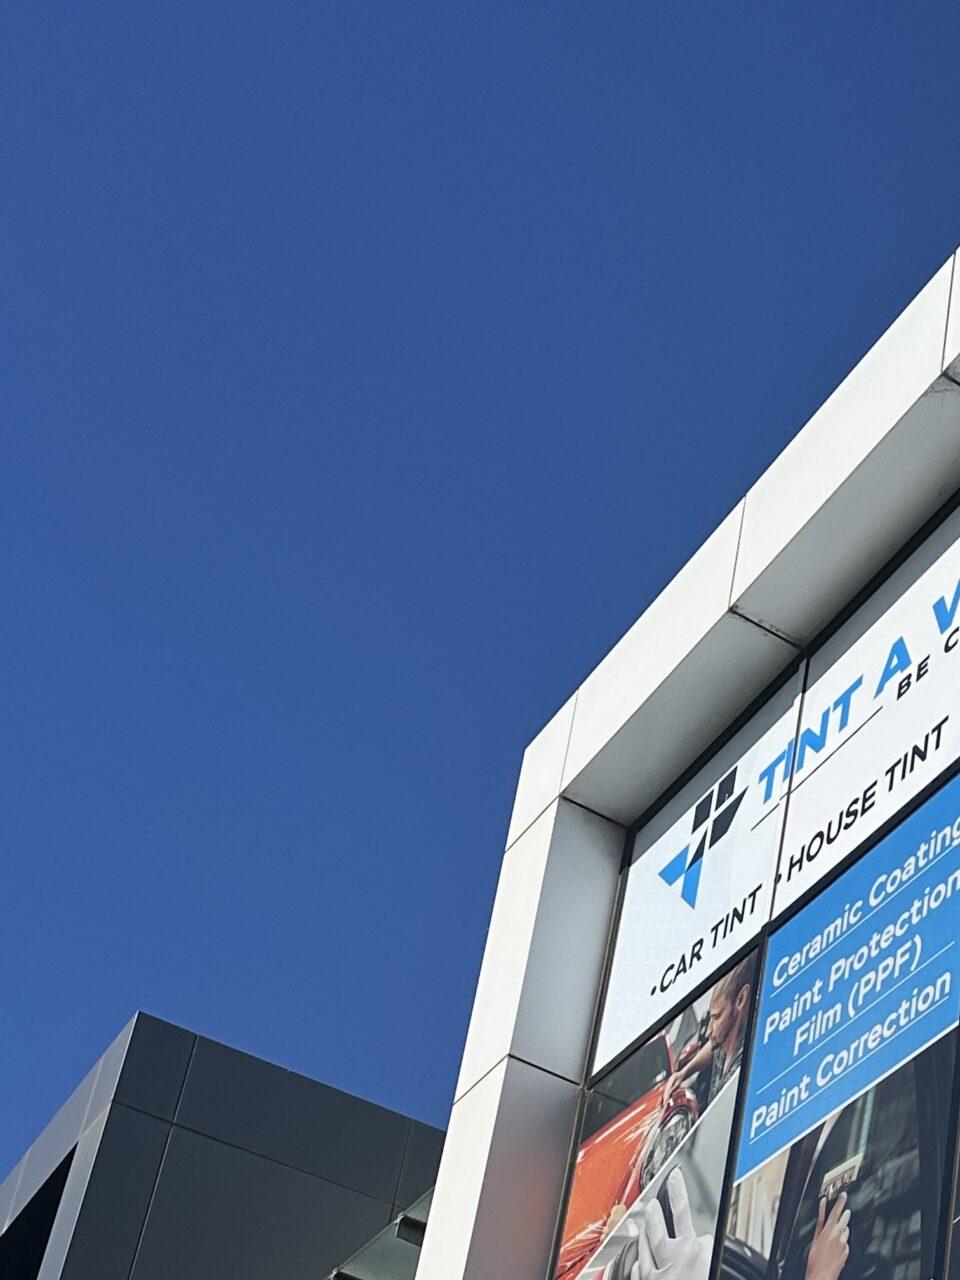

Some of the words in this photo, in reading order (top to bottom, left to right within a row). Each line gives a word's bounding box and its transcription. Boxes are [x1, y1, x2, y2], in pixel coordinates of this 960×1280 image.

[759, 674, 863, 805] TINT
[873, 636, 912, 700] A
[896, 654, 930, 701] BE
[710, 884, 762, 949] TINT
[786, 780, 878, 882] HOUSE
[885, 715, 949, 793] TINT
[772, 900, 863, 987] Ceramic
[793, 1006, 842, 1057] Film
[848, 935, 922, 1018] (PPF)
[749, 1074, 810, 1139] Paint
[815, 971, 952, 1086] Correction
[763, 983, 822, 1044] Paint
